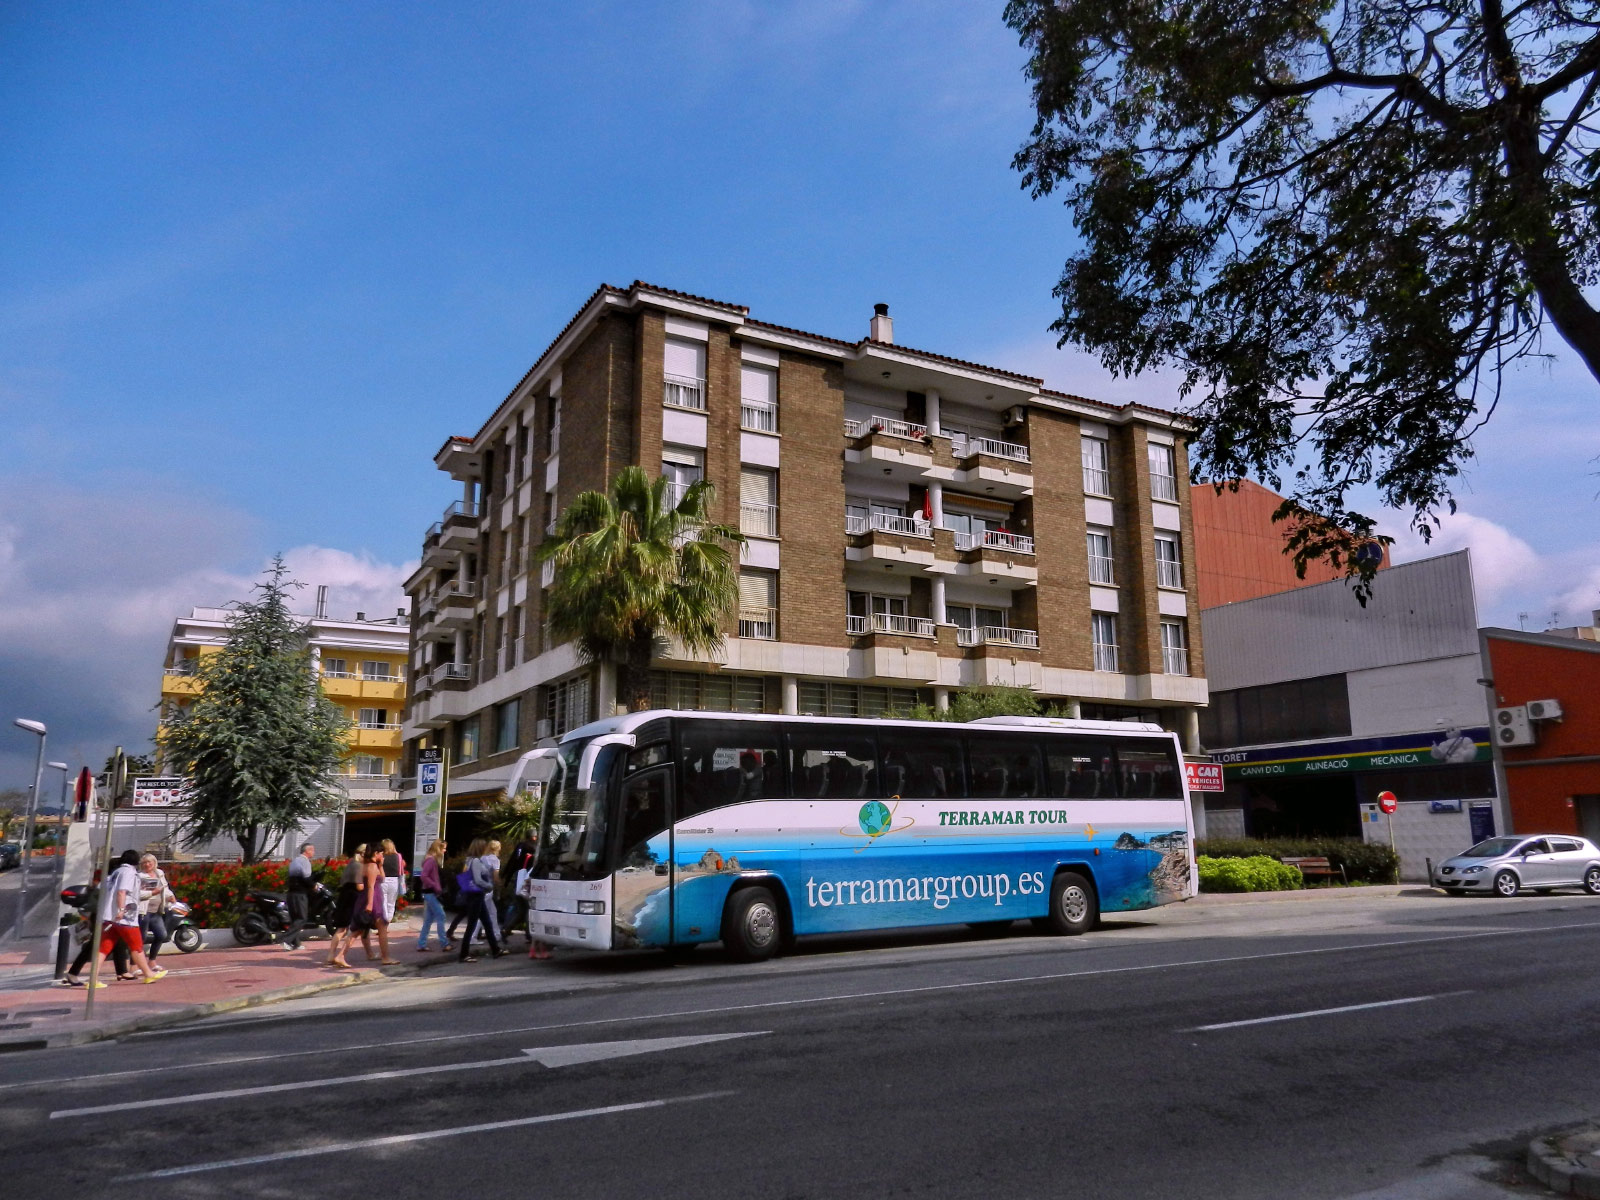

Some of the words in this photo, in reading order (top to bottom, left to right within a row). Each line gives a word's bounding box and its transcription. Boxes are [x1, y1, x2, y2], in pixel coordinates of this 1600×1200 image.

[425, 750, 437, 758] BUS
[1212, 752, 1248, 764] LLORET
[1240, 766, 1264, 776] CANVI
[1305, 758, 1349, 771] ALINEACIÓ
[1370, 753, 1419, 766] MECÀNICA
[1186, 766, 1195, 776] A
[1198, 766, 1219, 777] CAR
[1192, 777, 1220, 785] VEHICLES
[424, 785, 434, 793] 13
[938, 810, 1025, 826] TERRAMAR
[1028, 809, 1068, 825] TOUR
[589, 883, 603, 891] 269
[805, 870, 1045, 910] terramargroup.es
